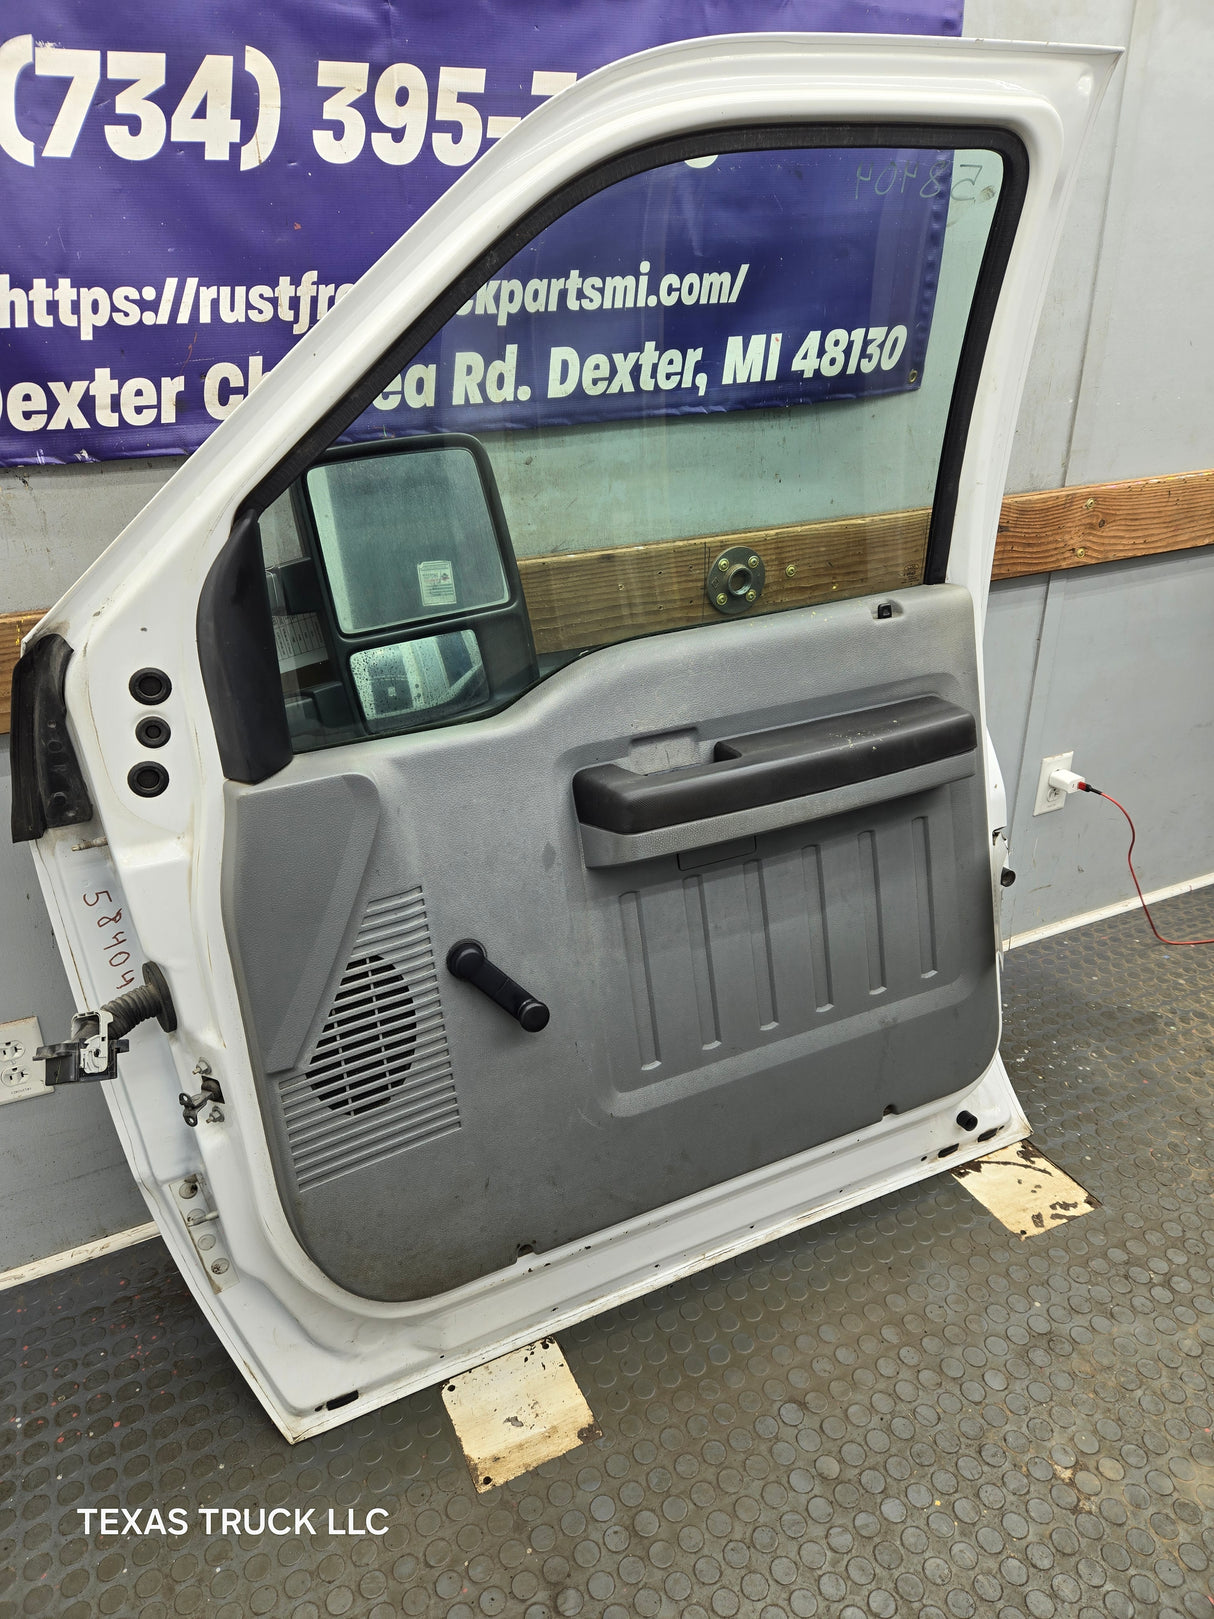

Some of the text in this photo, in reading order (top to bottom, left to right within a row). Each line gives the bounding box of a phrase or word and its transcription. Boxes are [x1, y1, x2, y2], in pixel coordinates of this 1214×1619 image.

[0, 34, 718, 171] (734) 395-
[0, 367, 185, 432] exter
[452, 344, 532, 405] Rd.
[548, 341, 708, 398] Dexter,
[722, 333, 783, 385] MI
[791, 324, 908, 378] 48130
[83, 890, 135, 990] 58404
